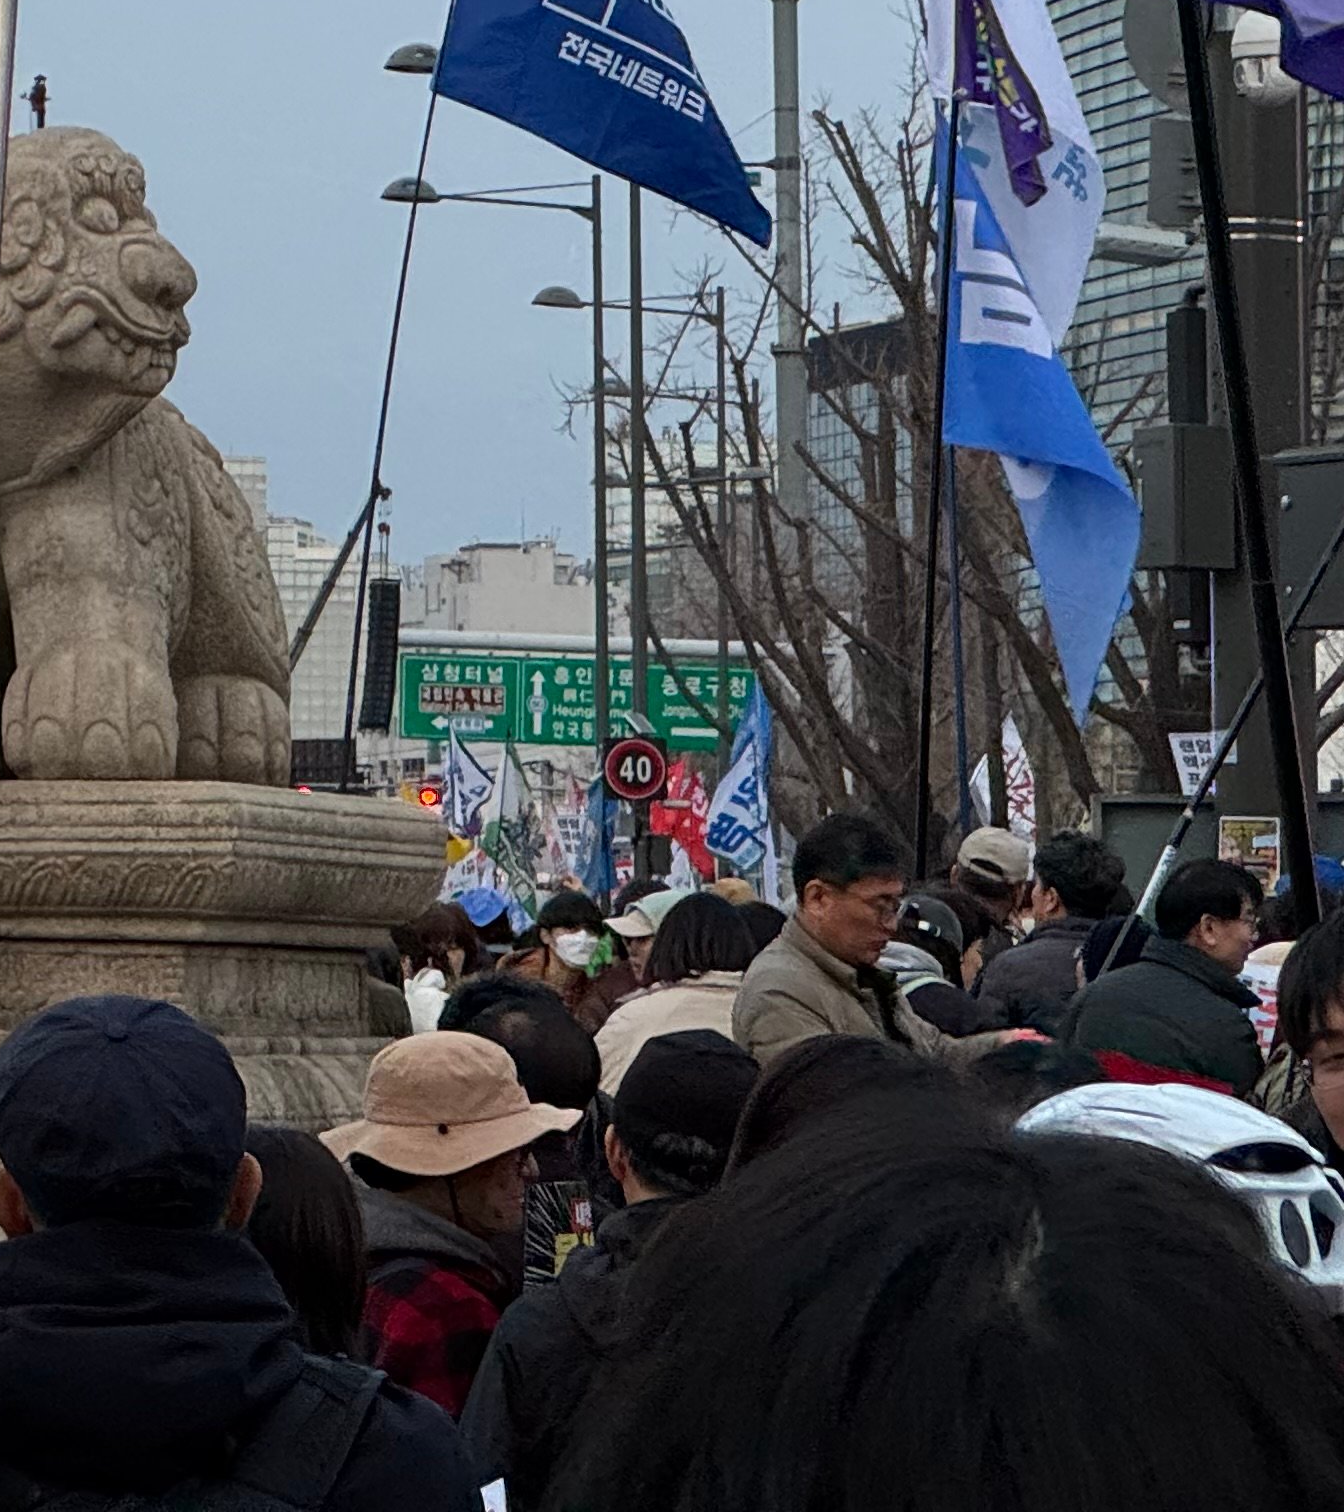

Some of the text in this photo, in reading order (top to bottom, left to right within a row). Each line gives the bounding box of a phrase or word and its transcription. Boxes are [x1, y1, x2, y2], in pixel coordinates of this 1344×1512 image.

[558, 31, 707, 123] 전국네트워크
[553, 665, 633, 687] 흥인문
[619, 756, 652, 783] 40
